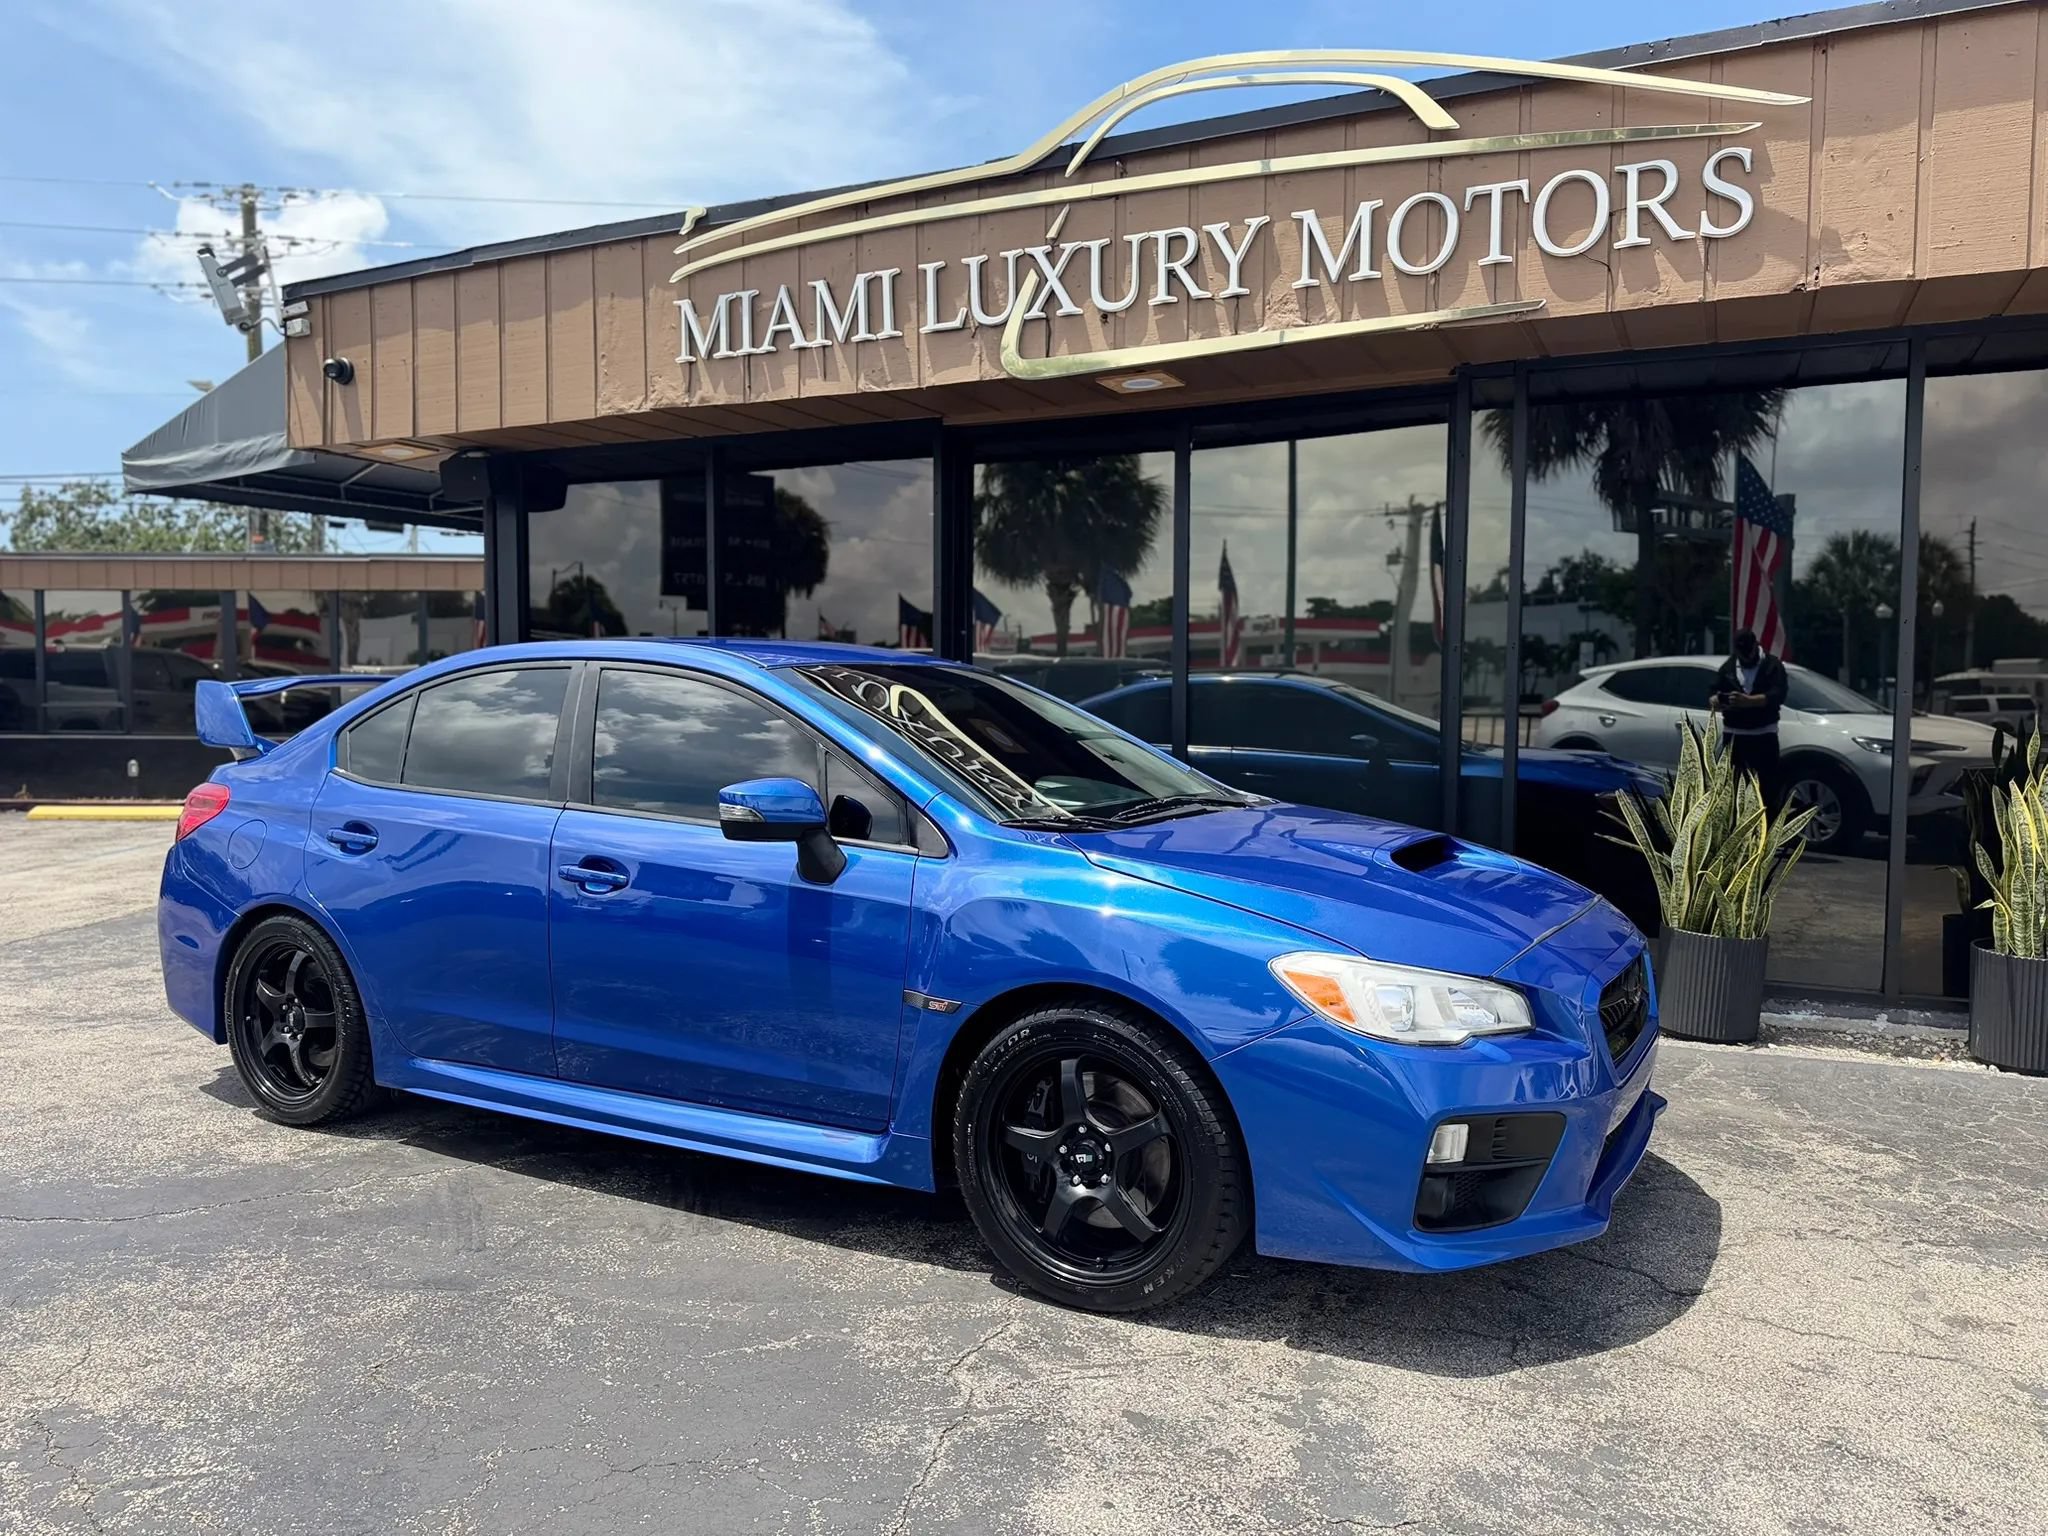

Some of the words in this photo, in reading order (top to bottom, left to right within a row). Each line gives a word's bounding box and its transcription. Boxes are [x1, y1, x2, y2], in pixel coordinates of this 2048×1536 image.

[672, 267, 903, 364] MIAMI
[918, 215, 1271, 336] LUXURY
[1291, 146, 1755, 290] MOTORS
